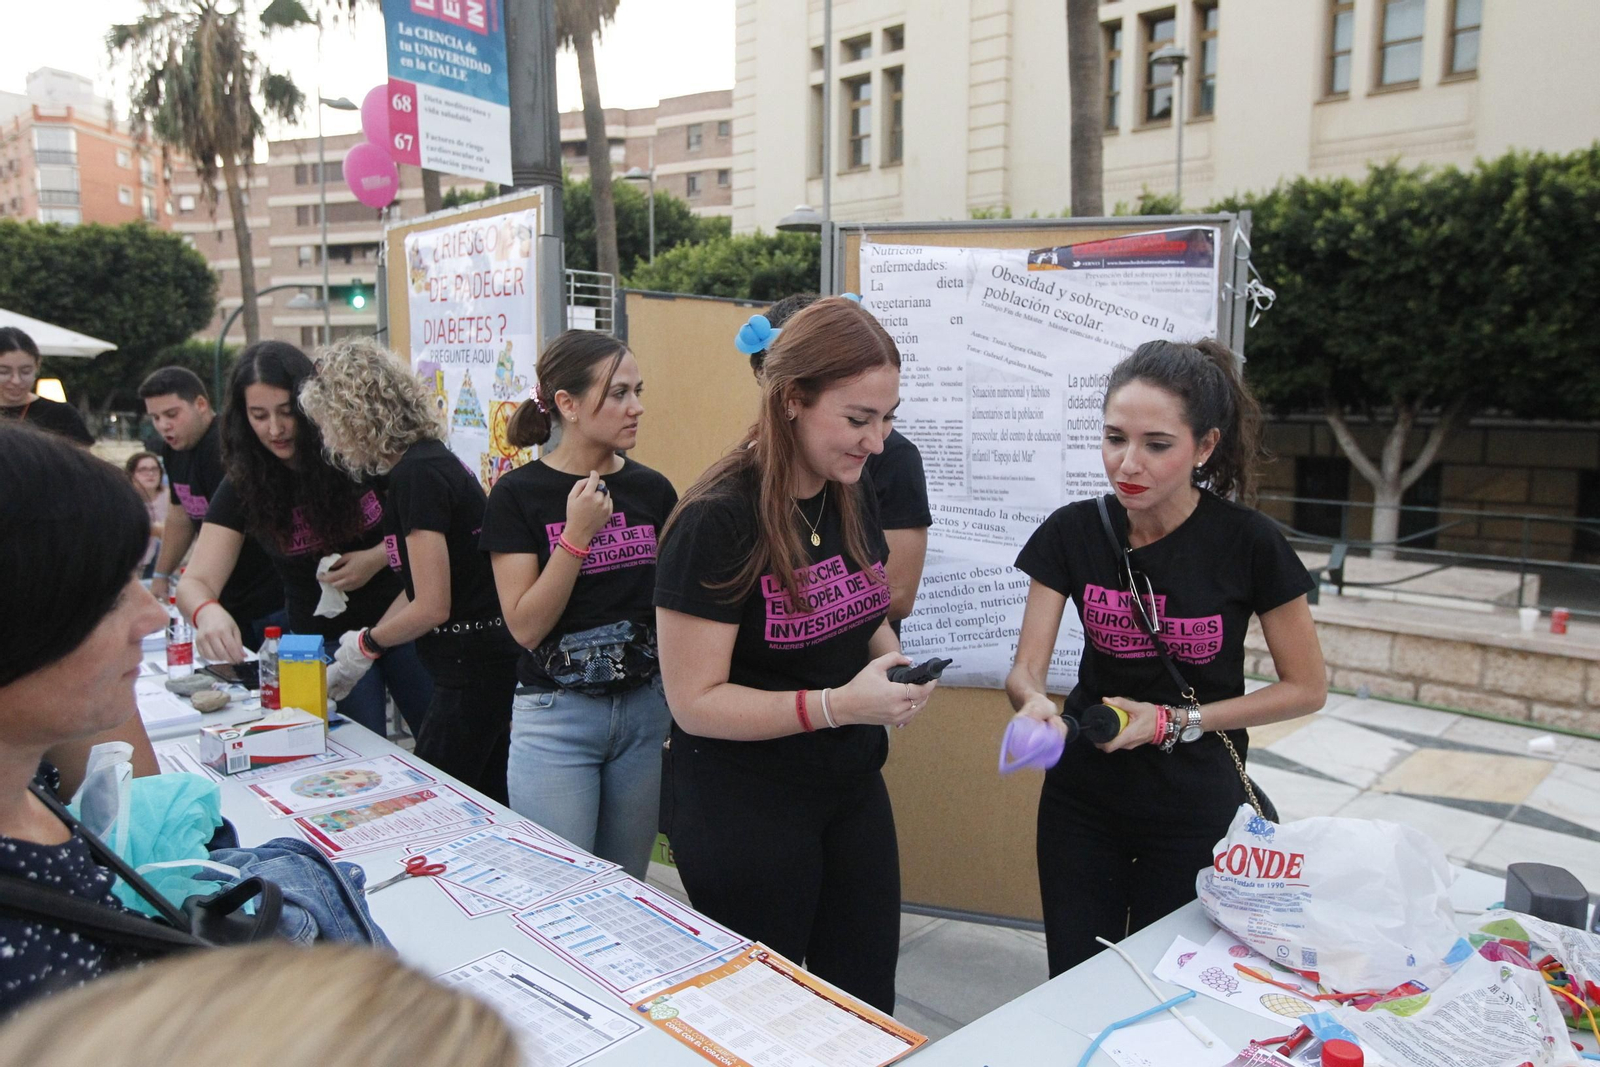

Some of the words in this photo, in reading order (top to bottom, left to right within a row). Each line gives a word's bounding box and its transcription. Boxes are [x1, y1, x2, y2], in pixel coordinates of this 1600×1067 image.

[398, 22, 413, 36] La
[412, 27, 464, 49] CIENCIA
[464, 40, 478, 55] de
[399, 40, 412, 52] tu
[414, 44, 492, 75] UNIVERSIDAD
[400, 57, 414, 68] en
[416, 58, 426, 70] la
[428, 62, 468, 82] CALLE
[392, 93, 412, 113] 68
[394, 132, 414, 152] 67
[871, 246, 922, 256] Nutrición
[870, 259, 948, 274] enfermedades:
[429, 276, 448, 302] DE
[454, 267, 525, 300] PADECER
[870, 280, 884, 292] La
[936, 276, 964, 290] dieta
[870, 295, 932, 312] vegetariana
[981, 300, 1003, 313] Trabajo
[983, 286, 1050, 315] población
[1054, 308, 1105, 332] escolar.
[991, 264, 1056, 296] Obesidad
[1057, 288, 1068, 302] y
[1069, 289, 1139, 321] sobrepeso
[1142, 314, 1160, 328] en
[1162, 316, 1176, 334] la
[424, 316, 492, 346] DIABETES
[498, 314, 508, 344] ?
[881, 314, 908, 326] tricta
[950, 316, 964, 325] en
[430, 349, 470, 364] PREGUNTE
[472, 349, 494, 364] AQUI
[1068, 374, 1078, 388] La
[972, 385, 996, 398] Situación
[997, 385, 1026, 398] nutricional
[1026, 389, 1030, 402] y
[1030, 385, 1050, 398] hábitos
[972, 407, 1004, 420] alimentarios
[1004, 410, 1010, 420] en
[1011, 407, 1017, 420] la
[1018, 407, 1044, 422] población
[972, 428, 1000, 444] preescolar,
[1000, 428, 1008, 442] del
[1010, 430, 1026, 442] centro
[1026, 429, 1034, 442] de
[1034, 428, 1062, 442] educación
[972, 450, 990, 462] infantil
[1012, 450, 1020, 462] del
[940, 503, 996, 518] aumentado
[999, 510, 1008, 520] la
[1011, 512, 1046, 524] obesid
[932, 514, 960, 527] fectos
[962, 521, 970, 530] y
[972, 521, 1009, 534] causas.
[621, 528, 640, 541] DE
[922, 569, 967, 587] paciente
[970, 566, 1002, 581] obeso
[772, 585, 844, 615] EUOPEA
[846, 576, 866, 594] DE
[928, 582, 975, 600] atendido
[978, 584, 992, 594] en
[994, 580, 1005, 592] la
[1088, 588, 1108, 606] LA
[936, 614, 952, 630] del
[955, 612, 1006, 630] complejo
[1180, 620, 1218, 637] L@S
[812, 631, 838, 645] HOMBRES
[838, 626, 848, 635] QUE
[848, 619, 864, 630] HACEN
[901, 634, 946, 650] pitalario
[948, 627, 1021, 645] Torrecárdena
[1115, 650, 1146, 659] HOMBRES
[1214, 844, 1304, 879] CONDE
[670, 1018, 693, 1034] COCINA
[692, 1032, 706, 1043] CON
[665, 1021, 684, 1034] COME
[682, 1031, 696, 1042] CON
[702, 1046, 732, 1066] CORAZÓN
